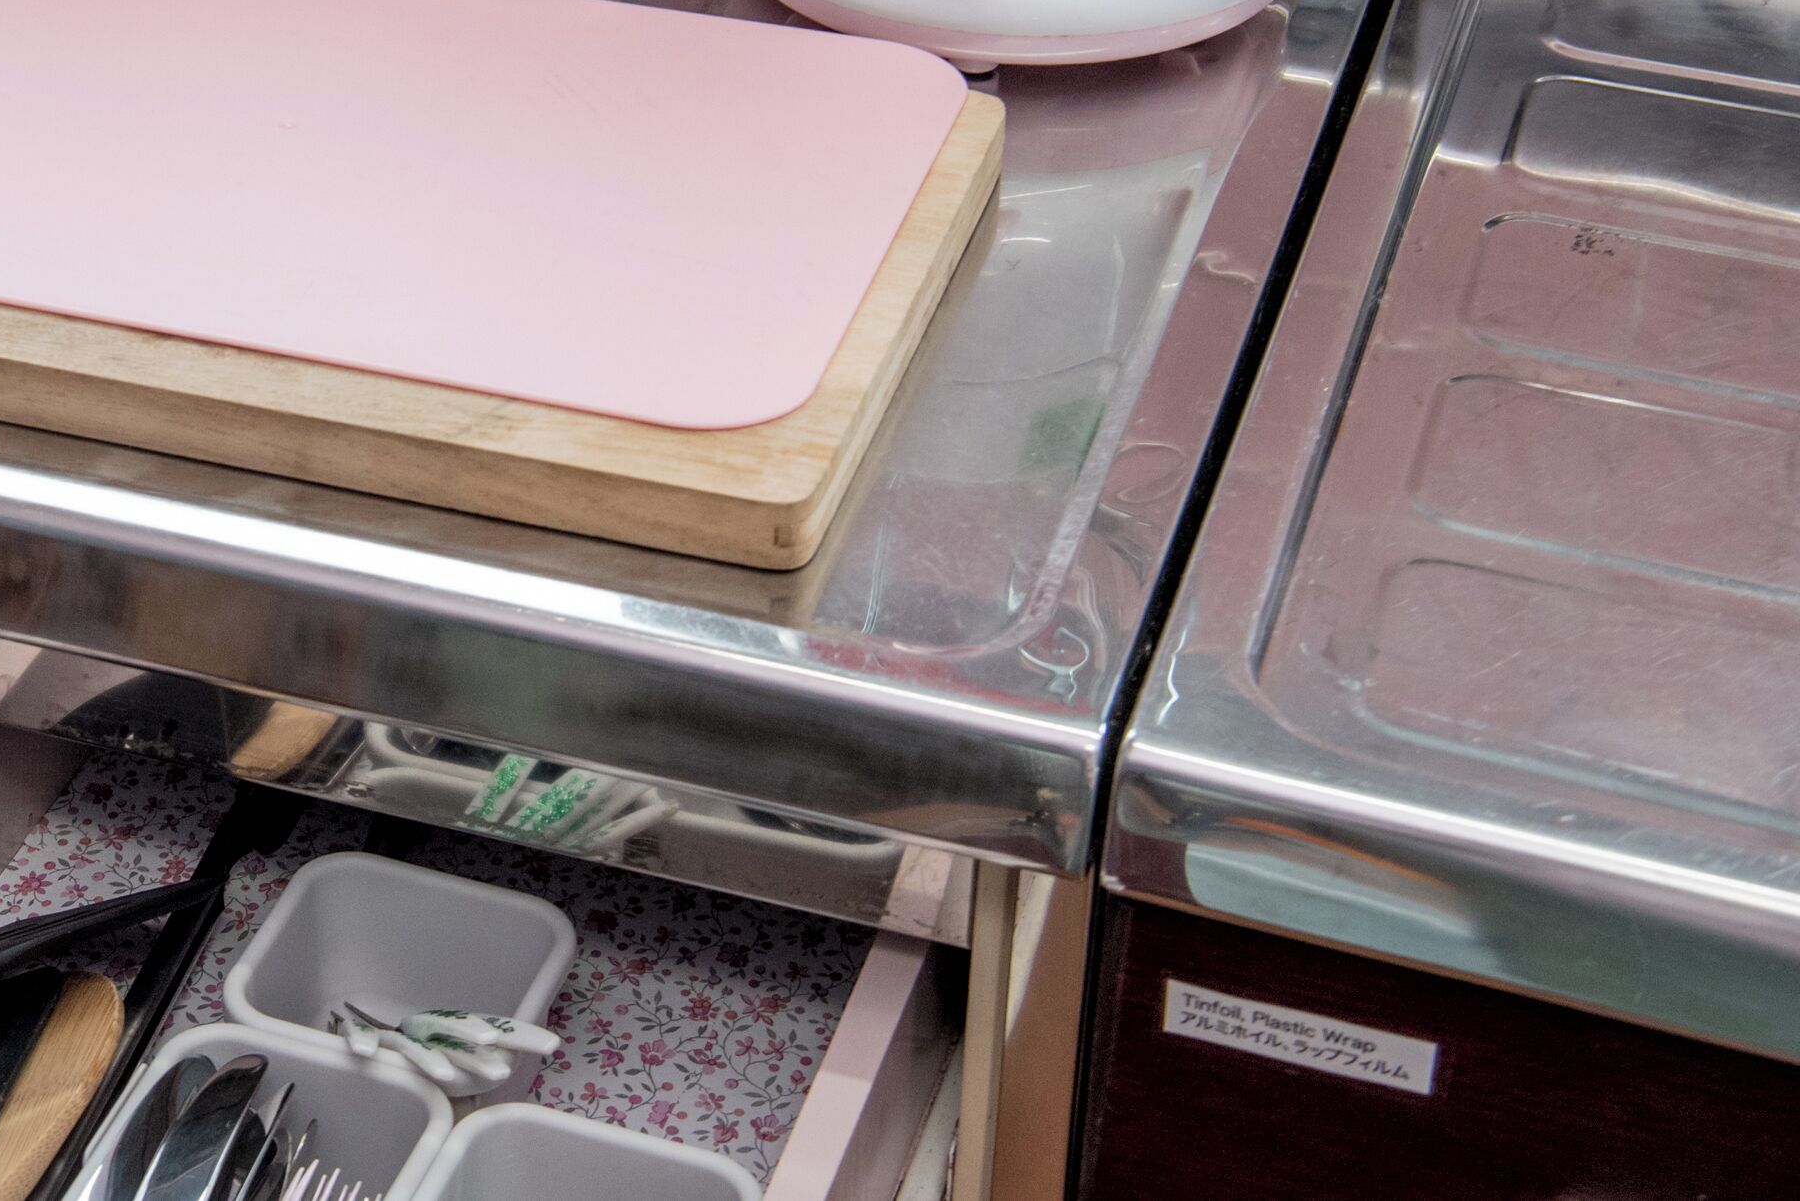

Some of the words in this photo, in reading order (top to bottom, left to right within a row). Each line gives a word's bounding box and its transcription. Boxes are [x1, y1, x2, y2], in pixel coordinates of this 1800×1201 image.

[1181, 991, 1246, 1023] Tinfoil,
[1252, 1011, 1316, 1040] Plastic
[1323, 1028, 1377, 1054] Wrap
